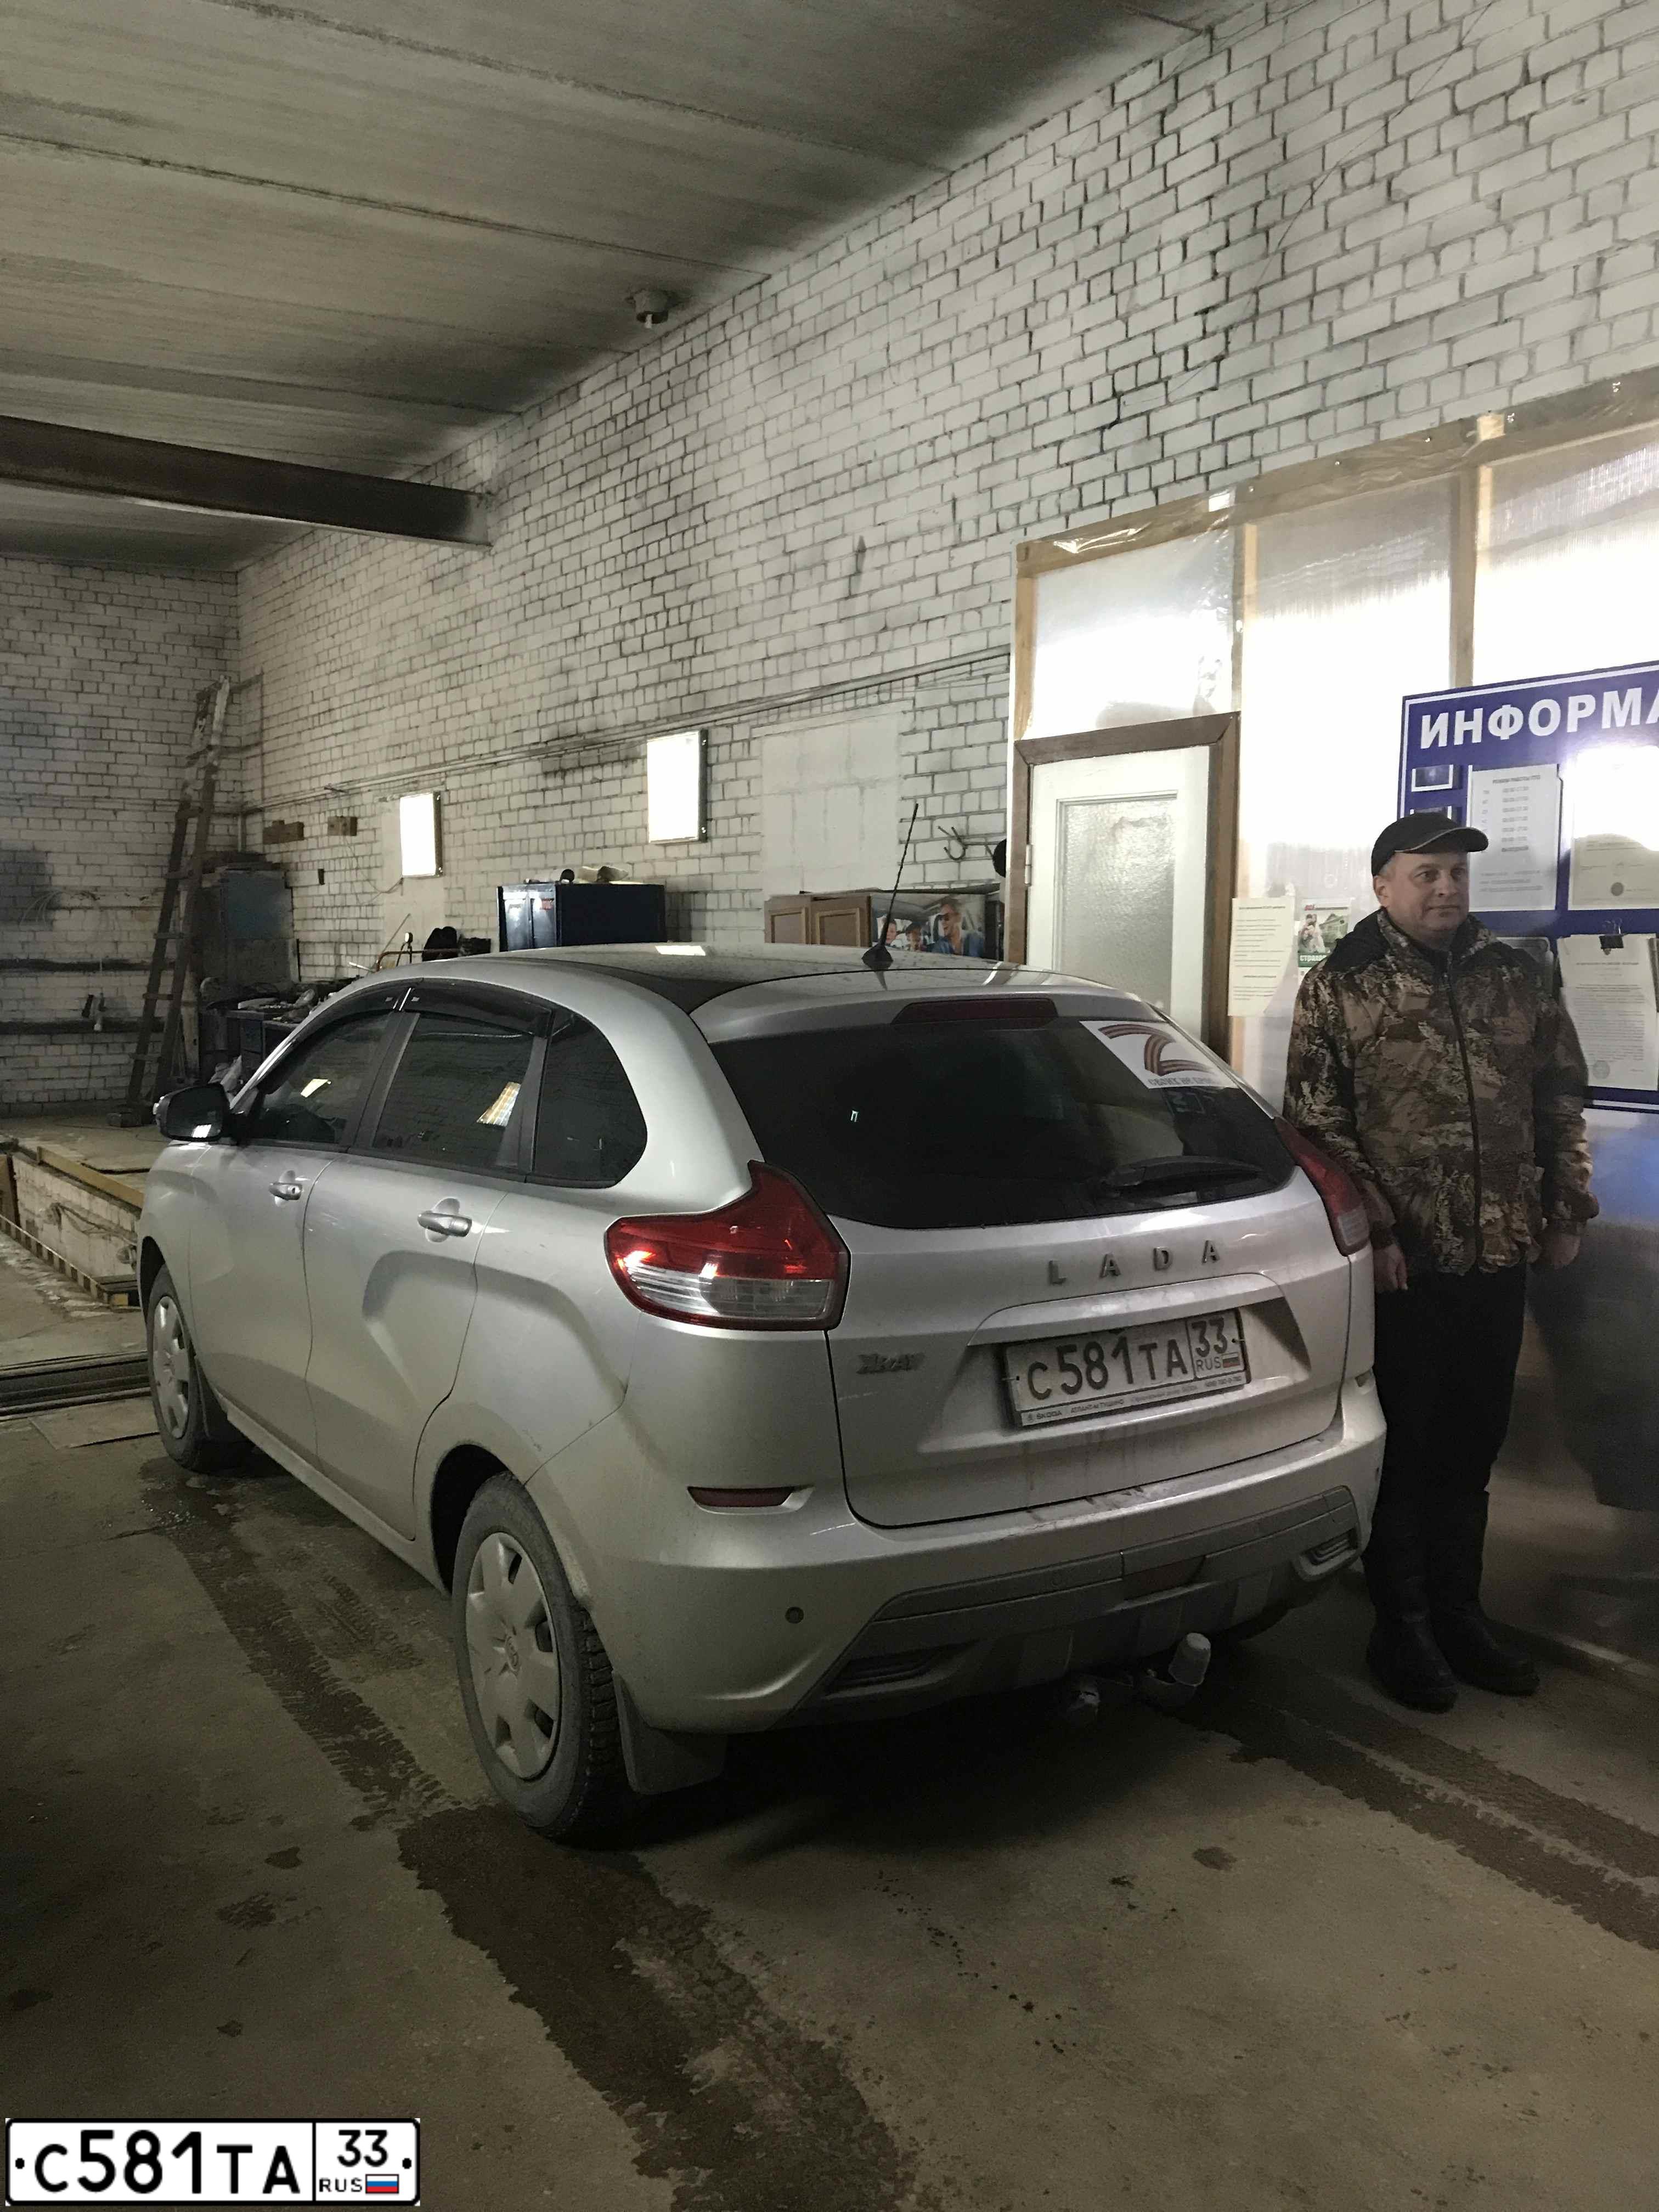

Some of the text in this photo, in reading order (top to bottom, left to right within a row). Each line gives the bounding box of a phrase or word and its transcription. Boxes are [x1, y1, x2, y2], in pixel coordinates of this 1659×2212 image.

[1048, 1239, 1221, 1286] LADA
[1190, 1316, 1228, 1358] 33
[1195, 1356, 1221, 1372] RUS
